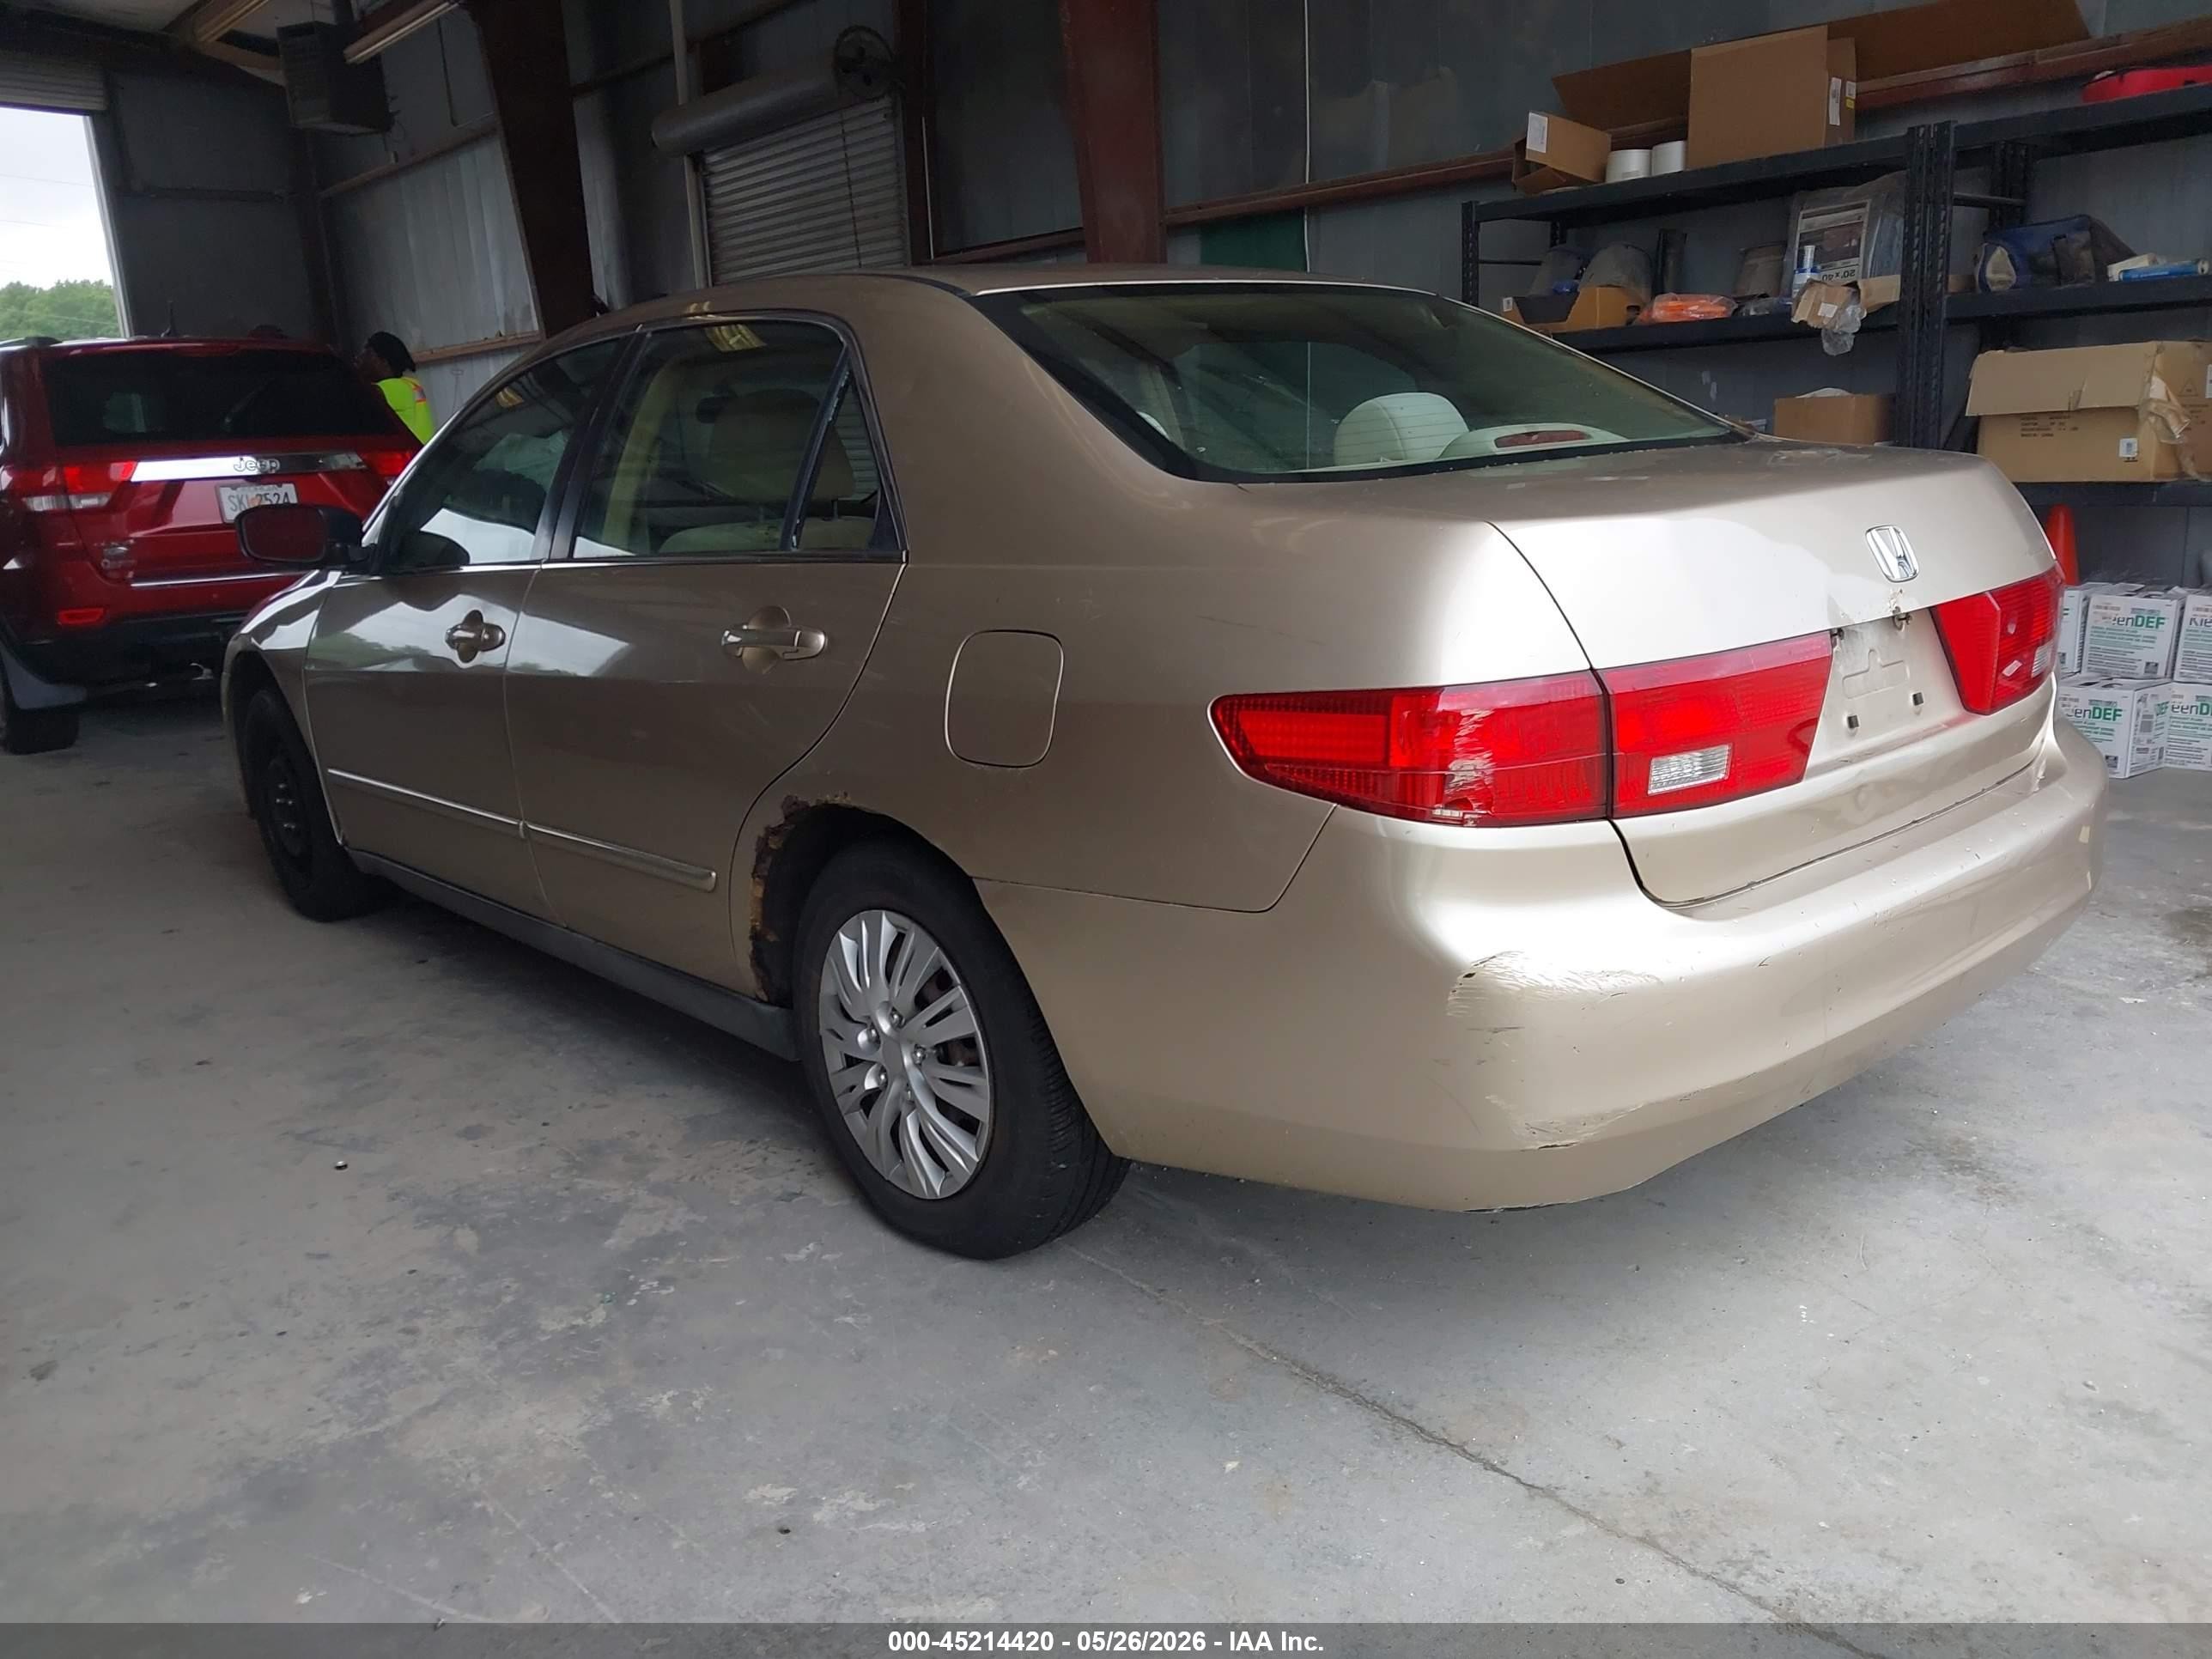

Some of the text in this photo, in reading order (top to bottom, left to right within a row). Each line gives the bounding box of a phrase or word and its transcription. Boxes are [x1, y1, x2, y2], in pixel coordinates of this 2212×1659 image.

[233, 457, 280, 474] Jeep
[2066, 706, 2123, 722] enDEF
[2172, 702, 2212, 716] eenD
